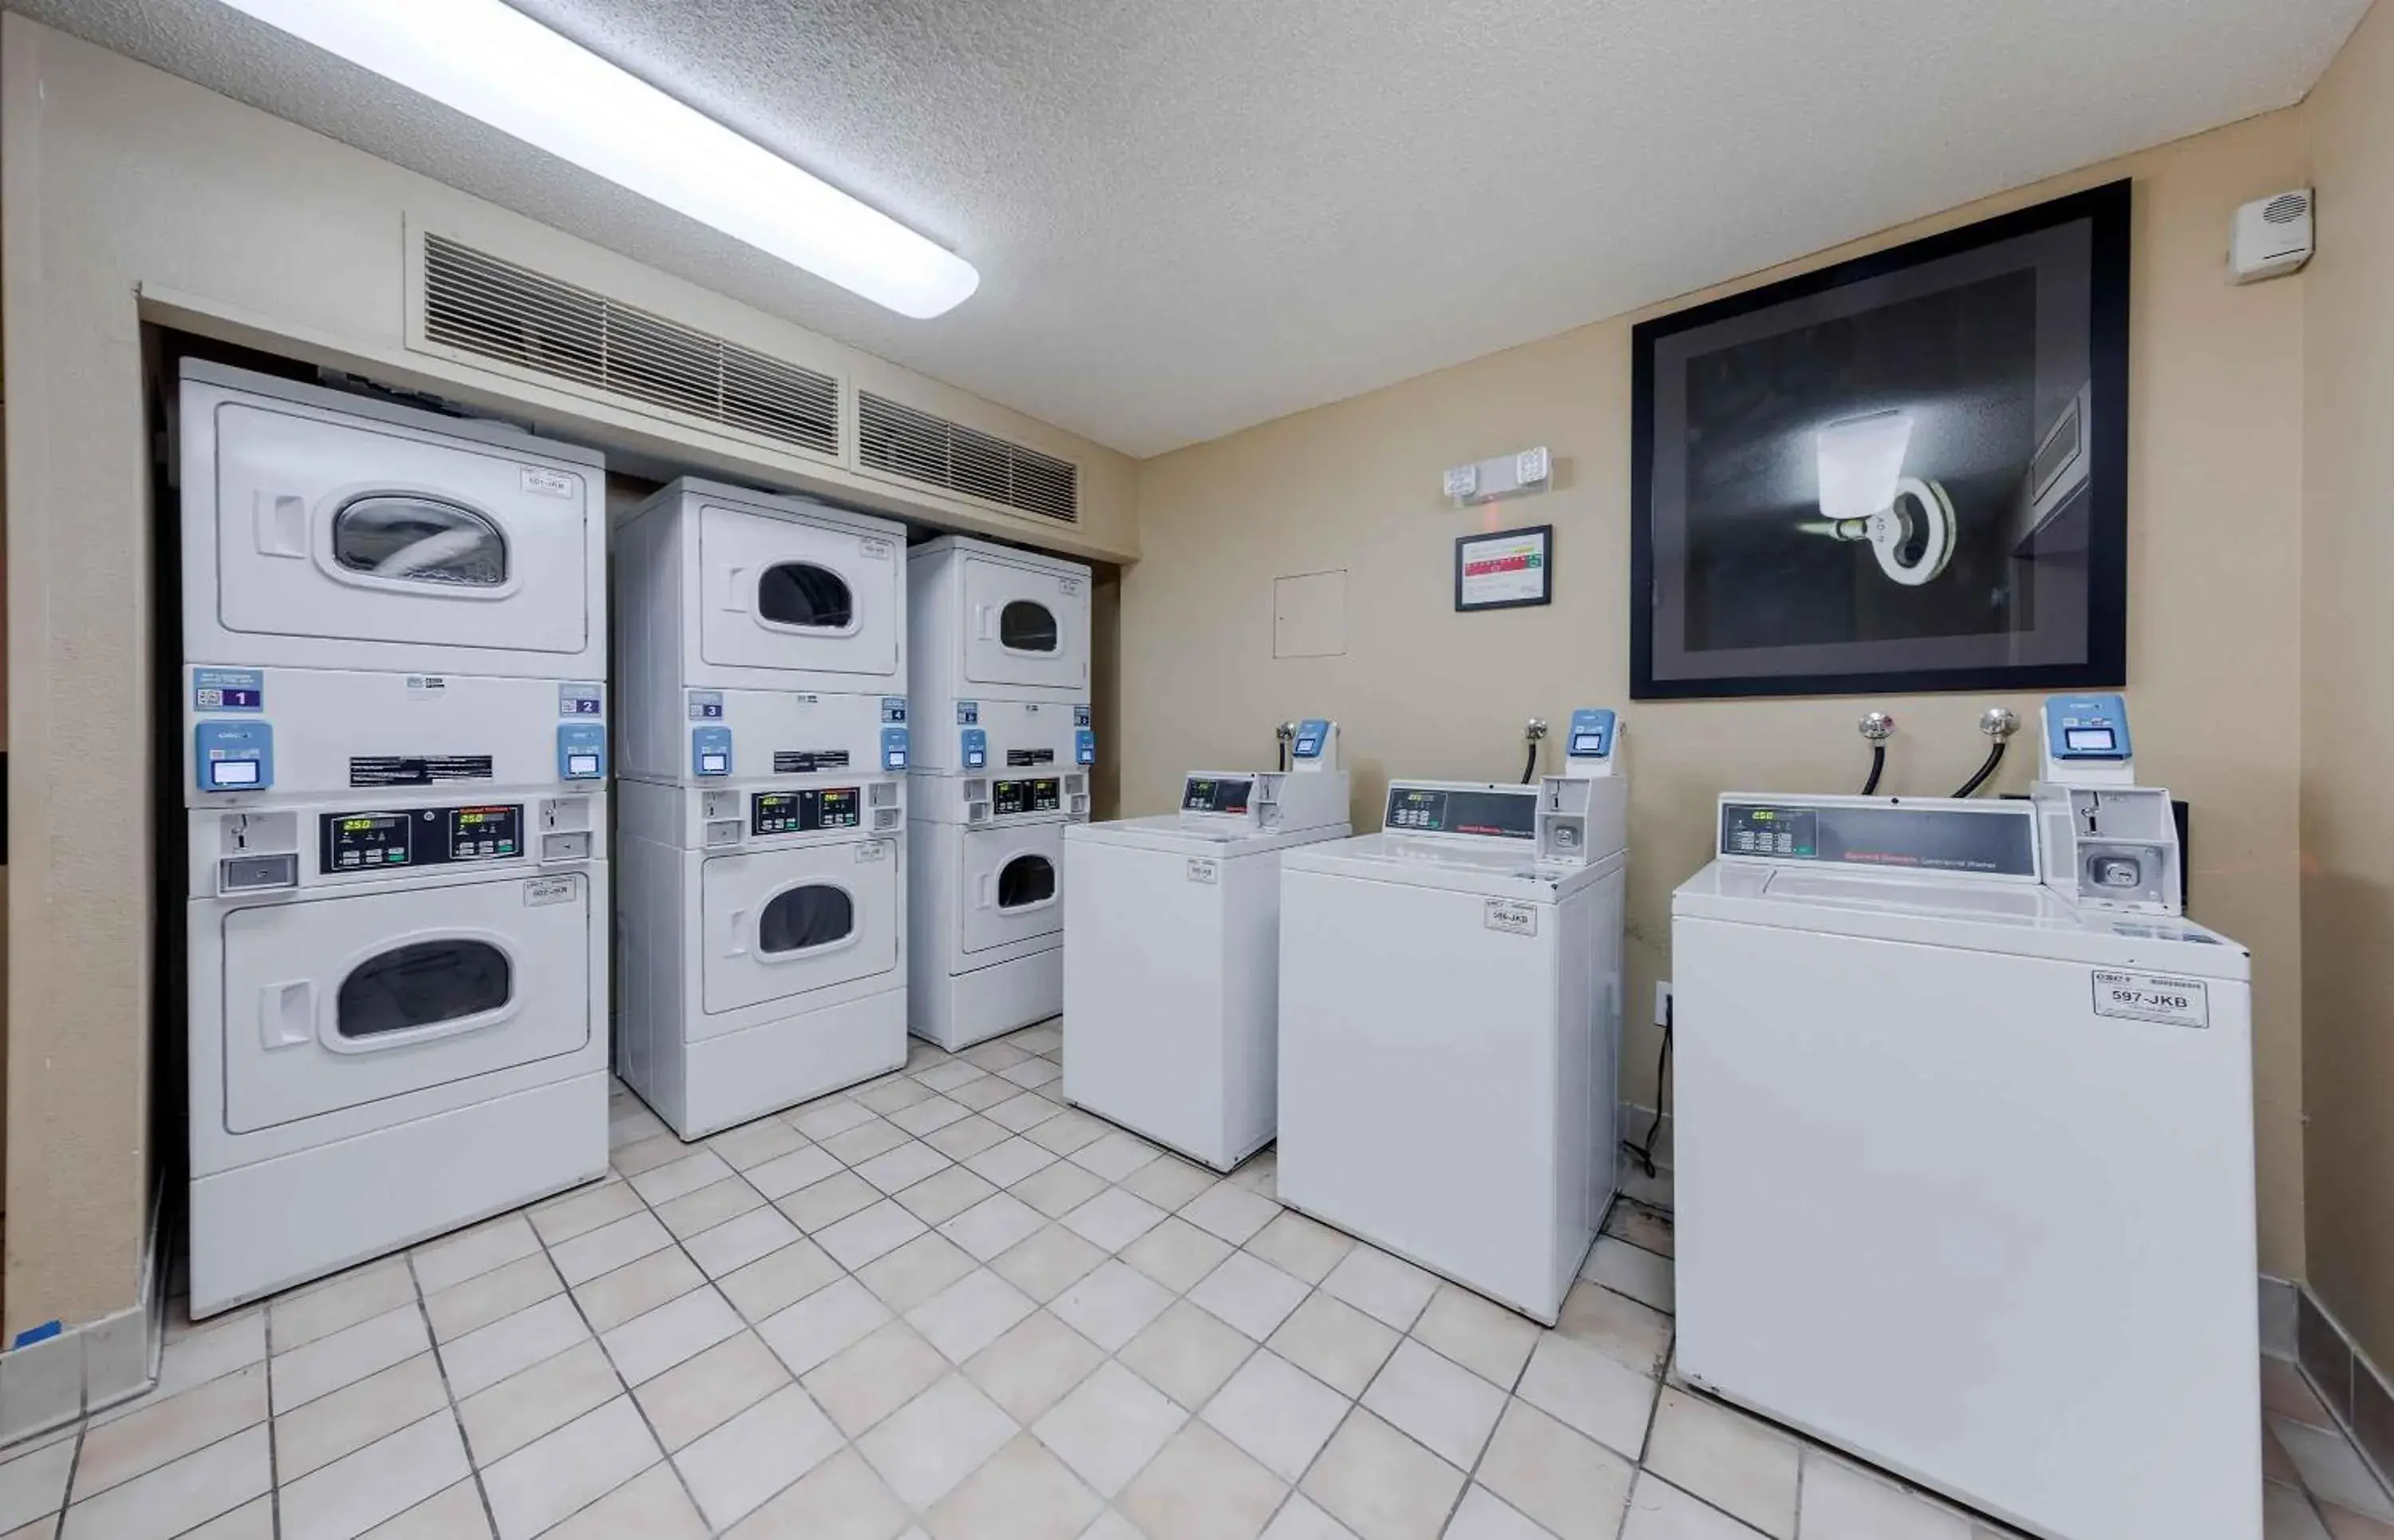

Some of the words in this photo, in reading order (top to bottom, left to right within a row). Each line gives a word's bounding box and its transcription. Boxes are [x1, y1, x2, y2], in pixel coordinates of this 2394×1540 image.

[236, 692, 246, 705] 1
[583, 701, 592, 713] 2
[708, 706, 716, 716] 3
[2112, 990, 2188, 1009] 597-JKB
